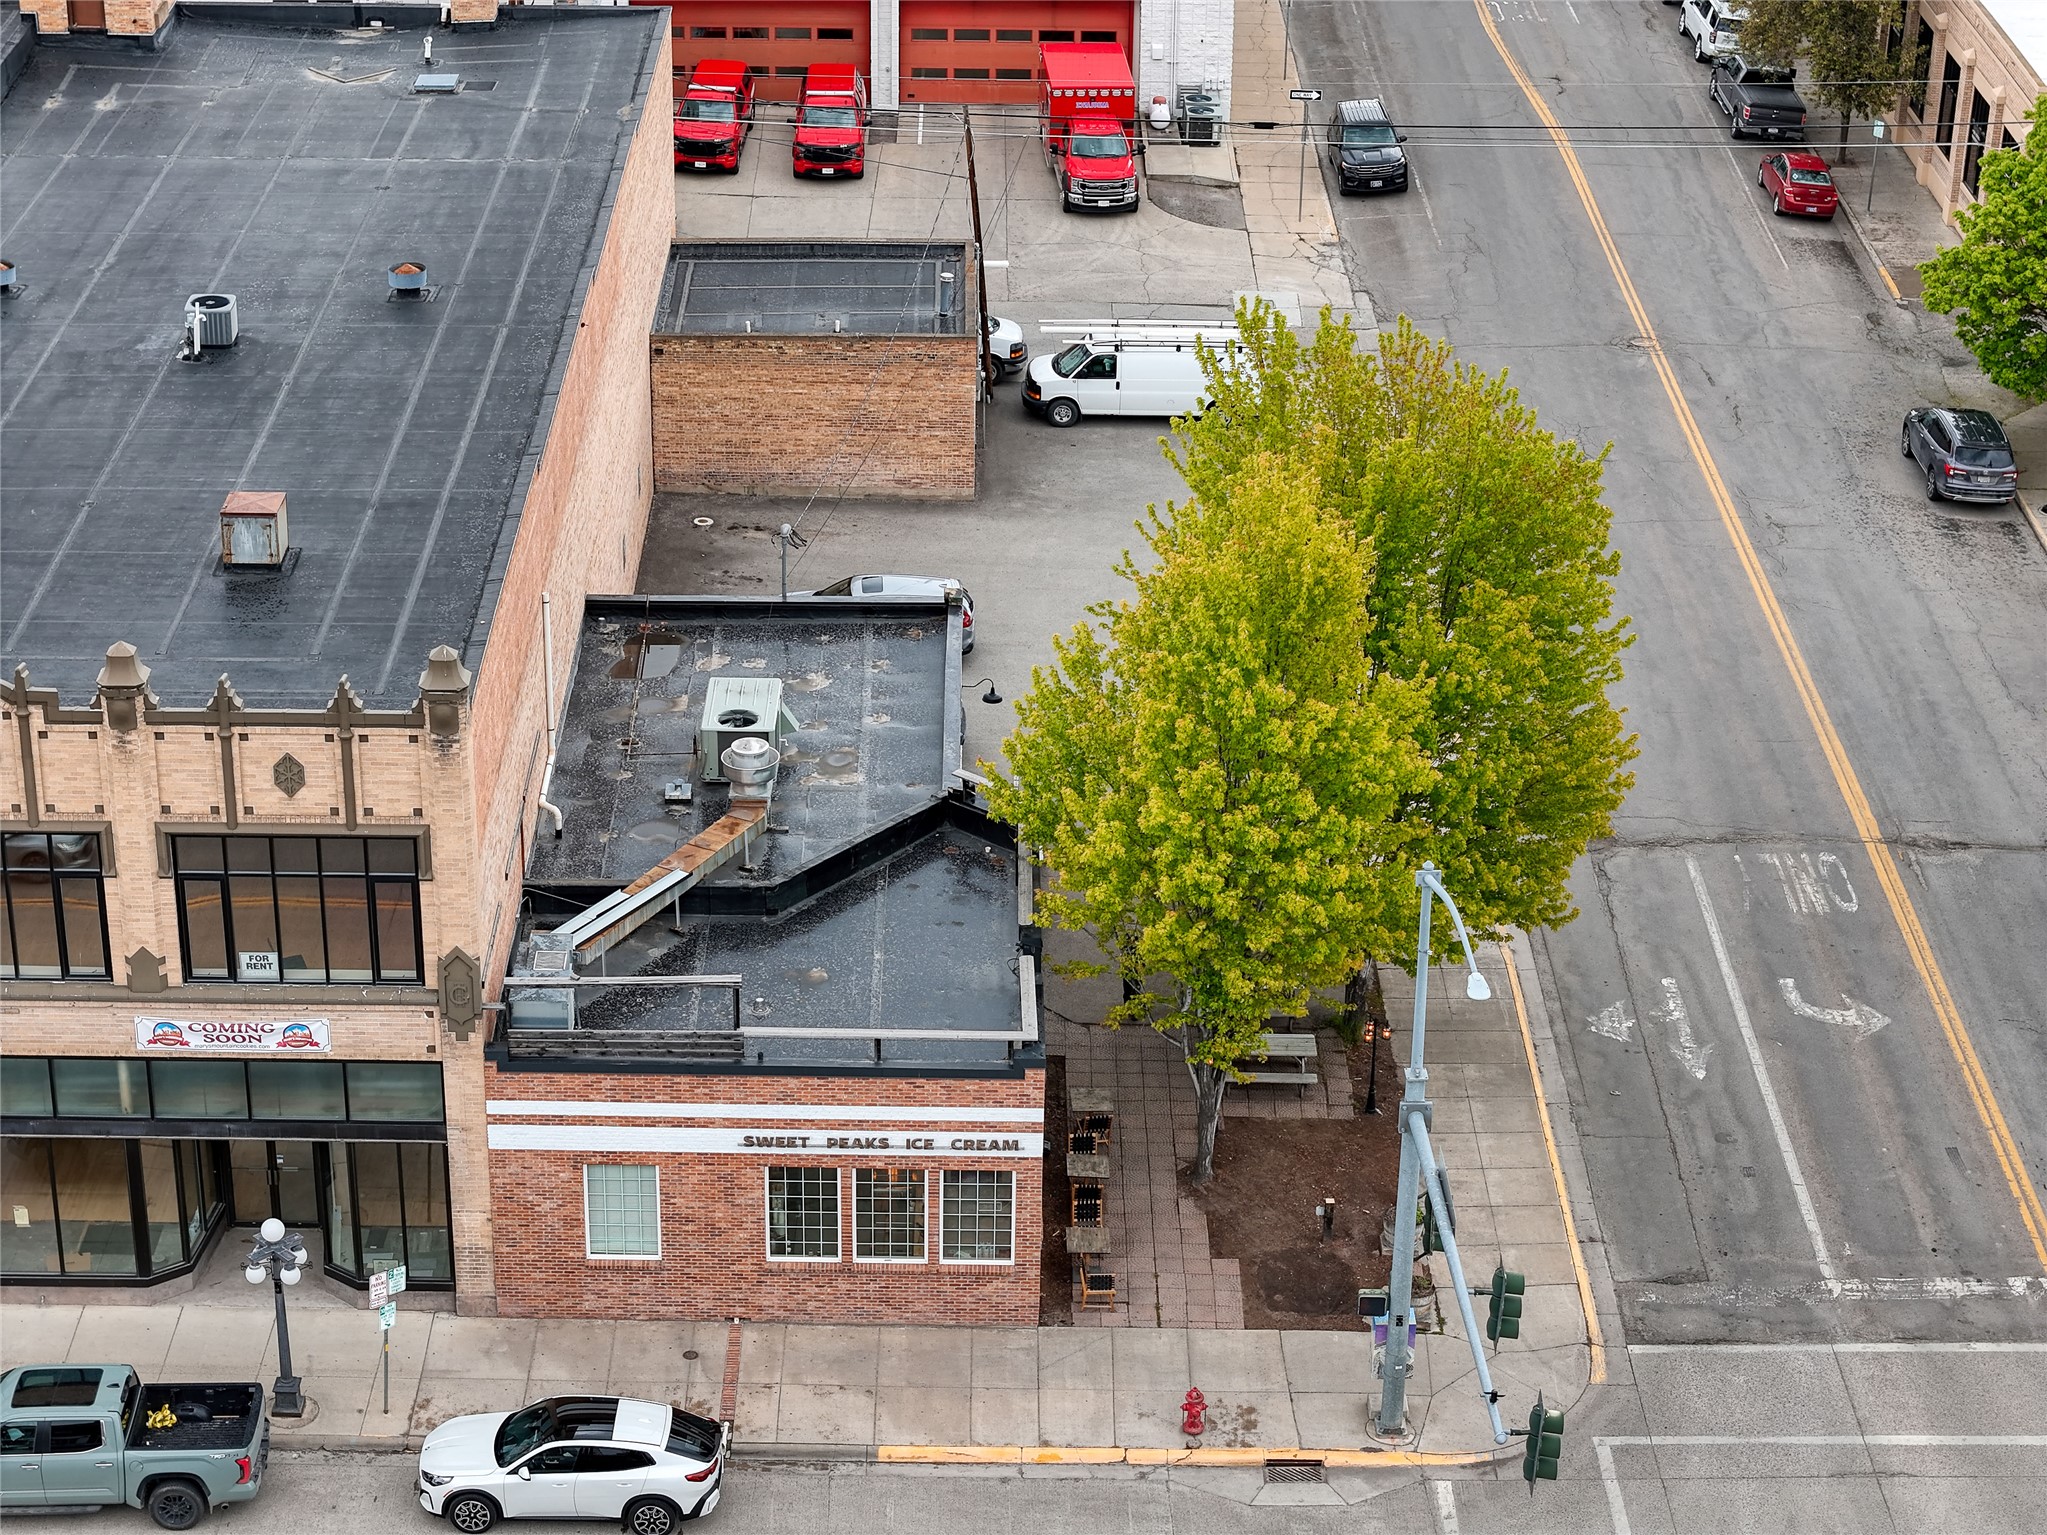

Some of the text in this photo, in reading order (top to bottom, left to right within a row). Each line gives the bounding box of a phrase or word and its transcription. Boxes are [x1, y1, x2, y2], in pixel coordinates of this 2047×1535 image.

[249, 954, 269, 962] FOR
[246, 962, 274, 970] RENT
[187, 1022, 276, 1034] COMING
[203, 1034, 262, 1043] SOON
[743, 1135, 1019, 1151] SWEET PEAKS ICE CREAM
